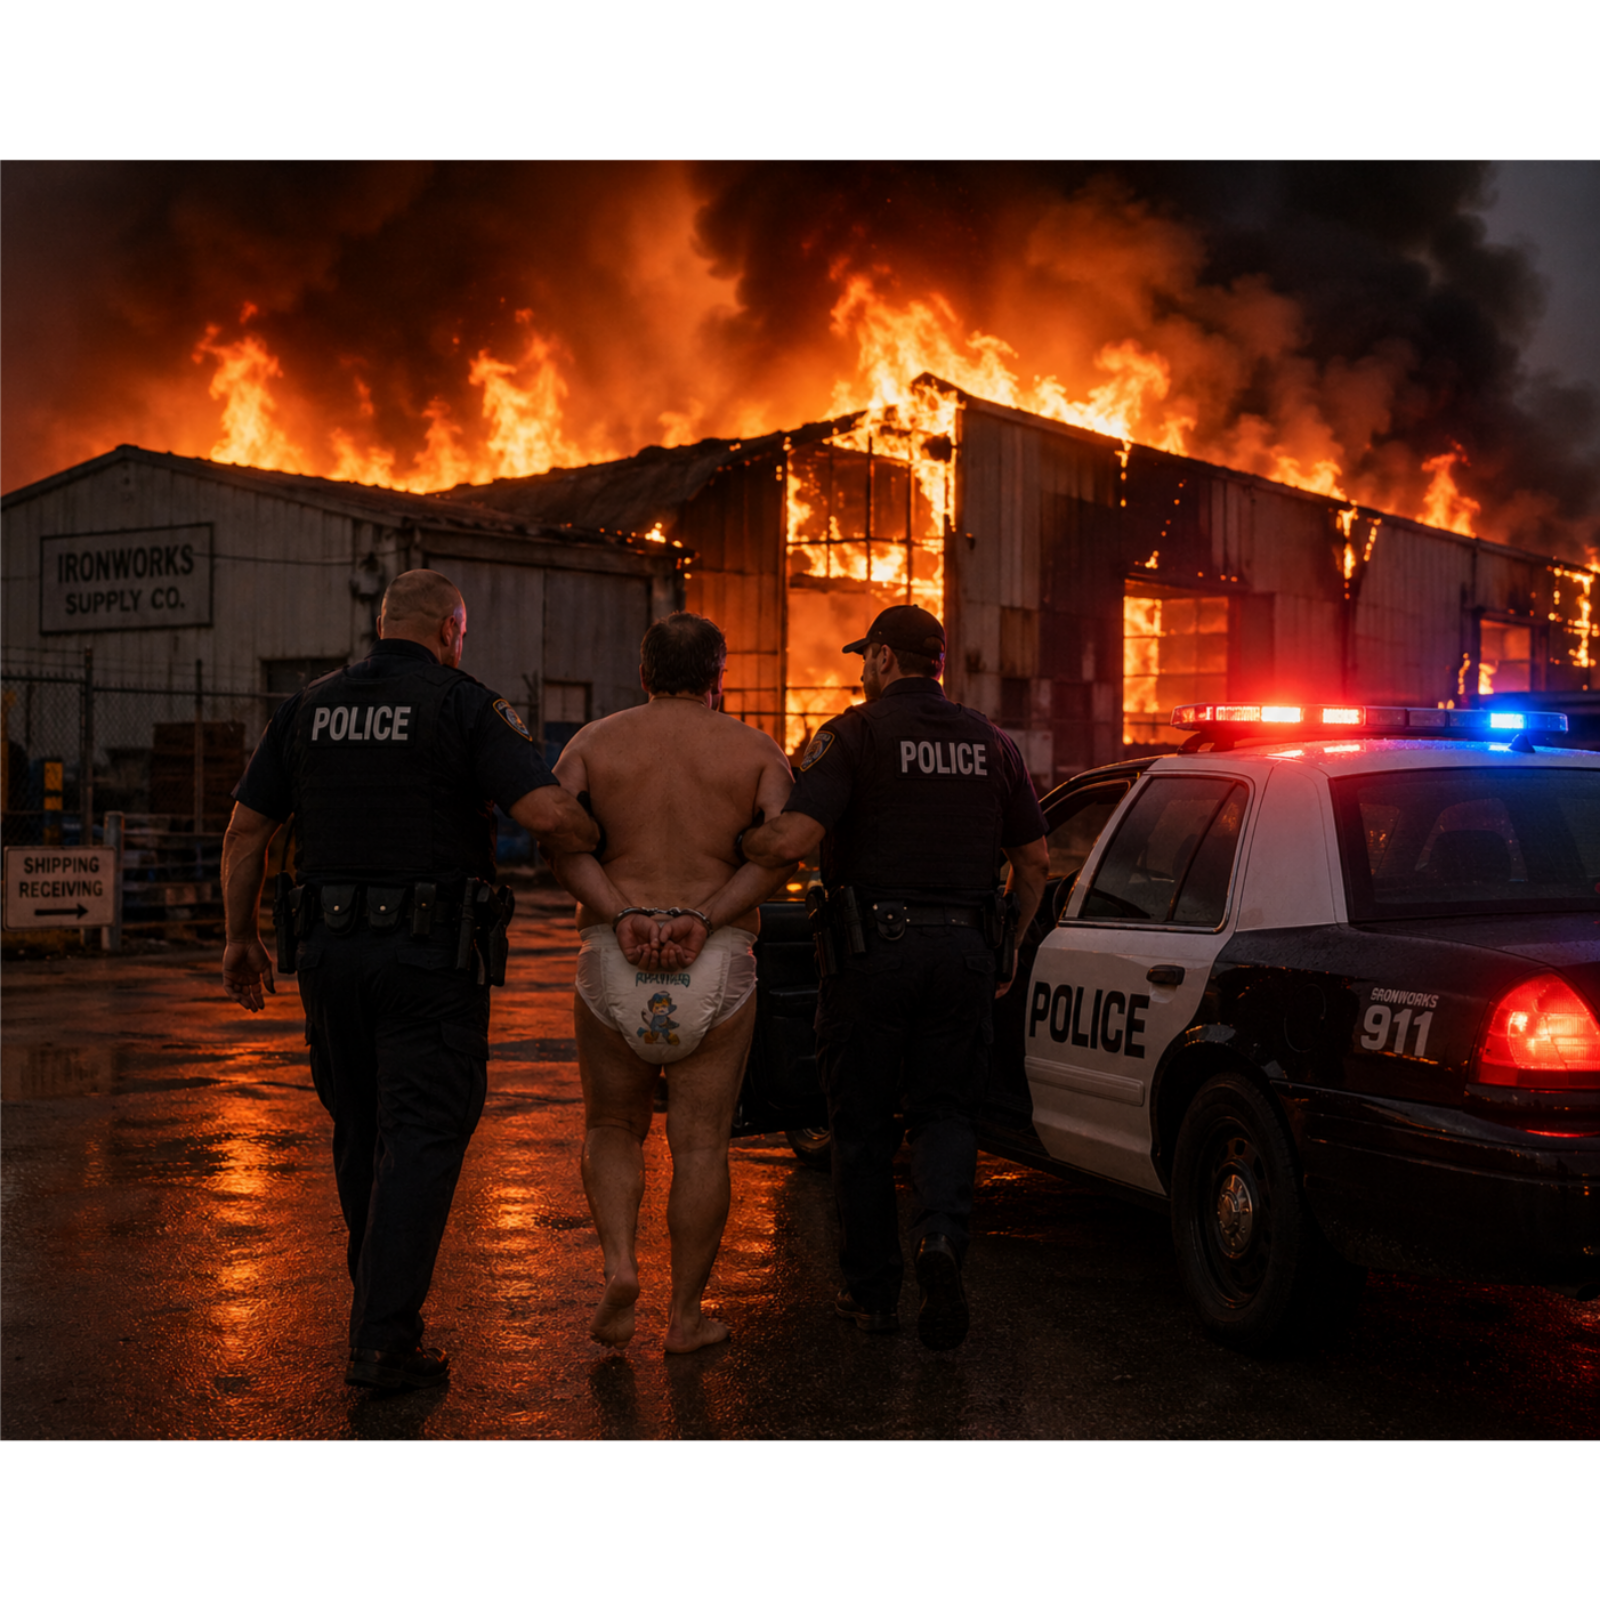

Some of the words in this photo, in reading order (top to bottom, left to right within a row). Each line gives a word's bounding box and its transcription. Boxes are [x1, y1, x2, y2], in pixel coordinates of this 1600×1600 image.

[58, 544, 194, 583] IRONWORKS
[66, 590, 142, 615] SUPPLY
[152, 587, 185, 609] CO.
[311, 706, 411, 741] POLICE
[900, 741, 988, 776] POLICE
[24, 857, 99, 874] SHIPPING
[19, 881, 103, 898] RECEIVING
[1029, 981, 1150, 1059] POLICE
[1360, 1004, 1434, 1056] 911
